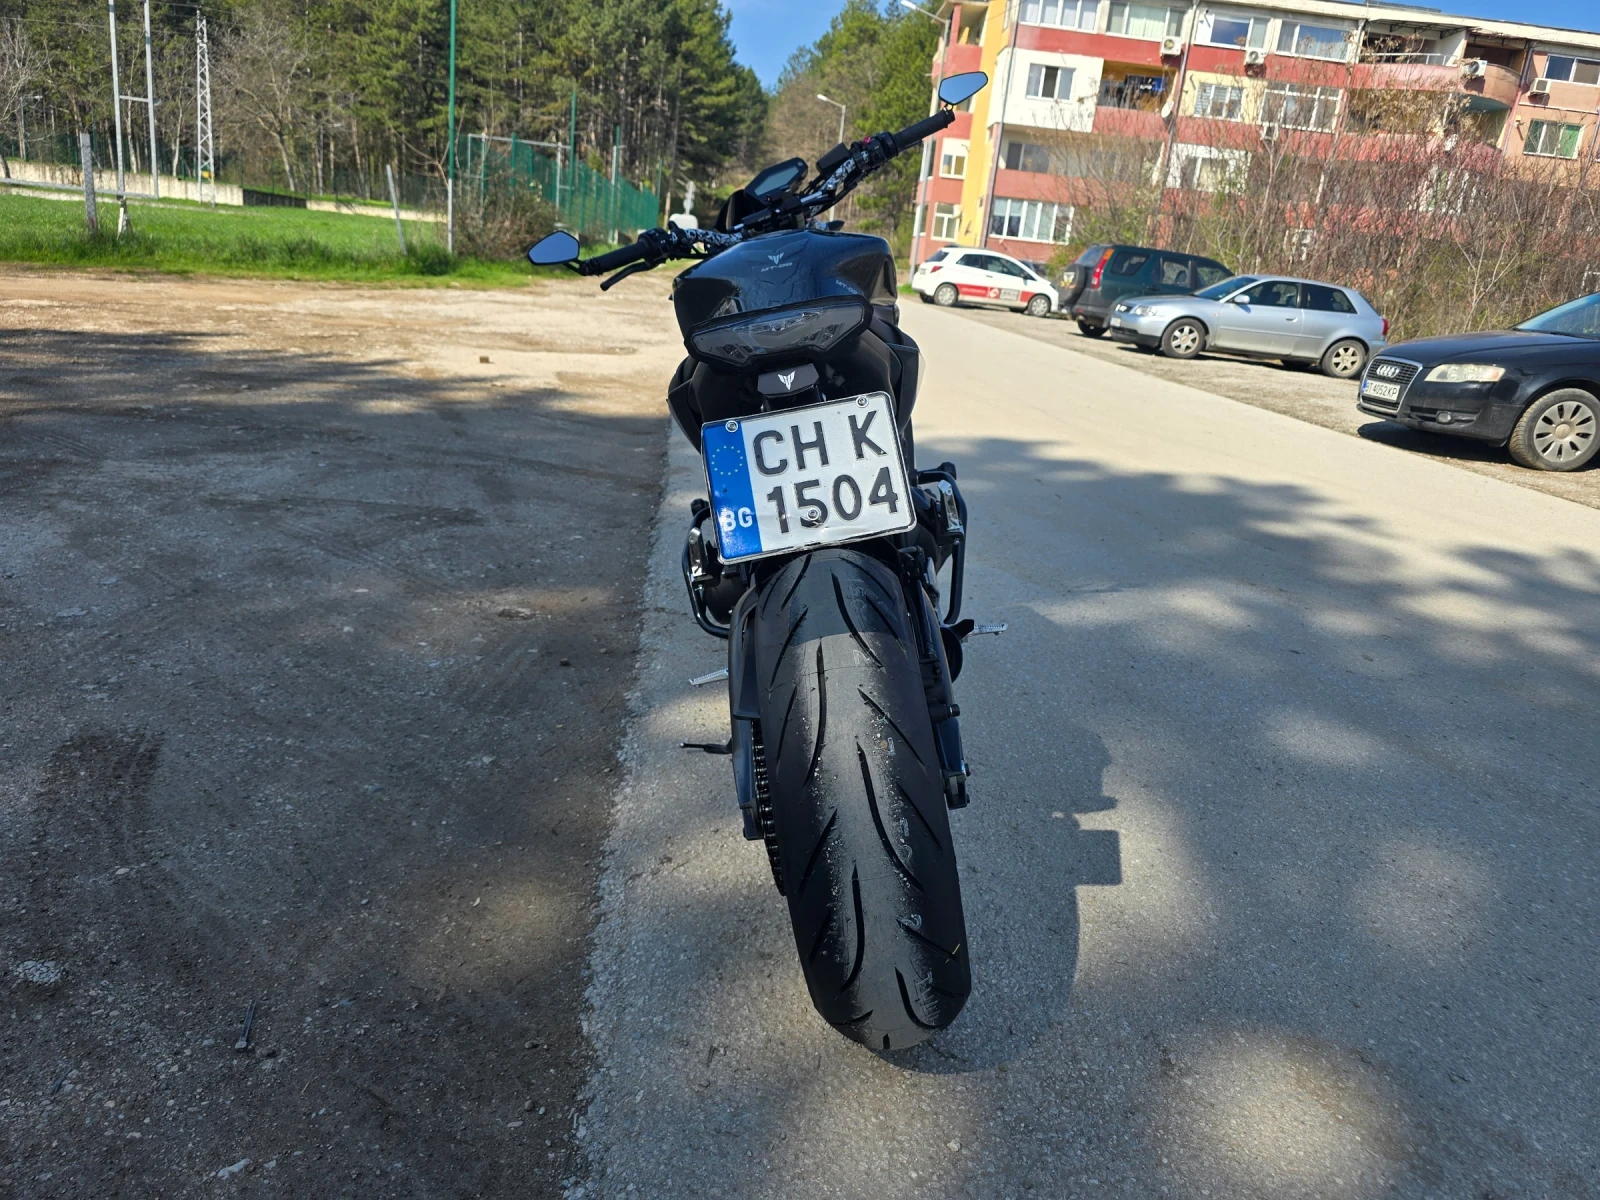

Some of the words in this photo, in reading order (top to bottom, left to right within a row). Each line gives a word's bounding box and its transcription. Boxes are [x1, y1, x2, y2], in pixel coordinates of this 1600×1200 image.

[752, 421, 829, 476] CH
[847, 410, 888, 460] K
[718, 506, 753, 532] BG
[766, 466, 899, 534] 1504
